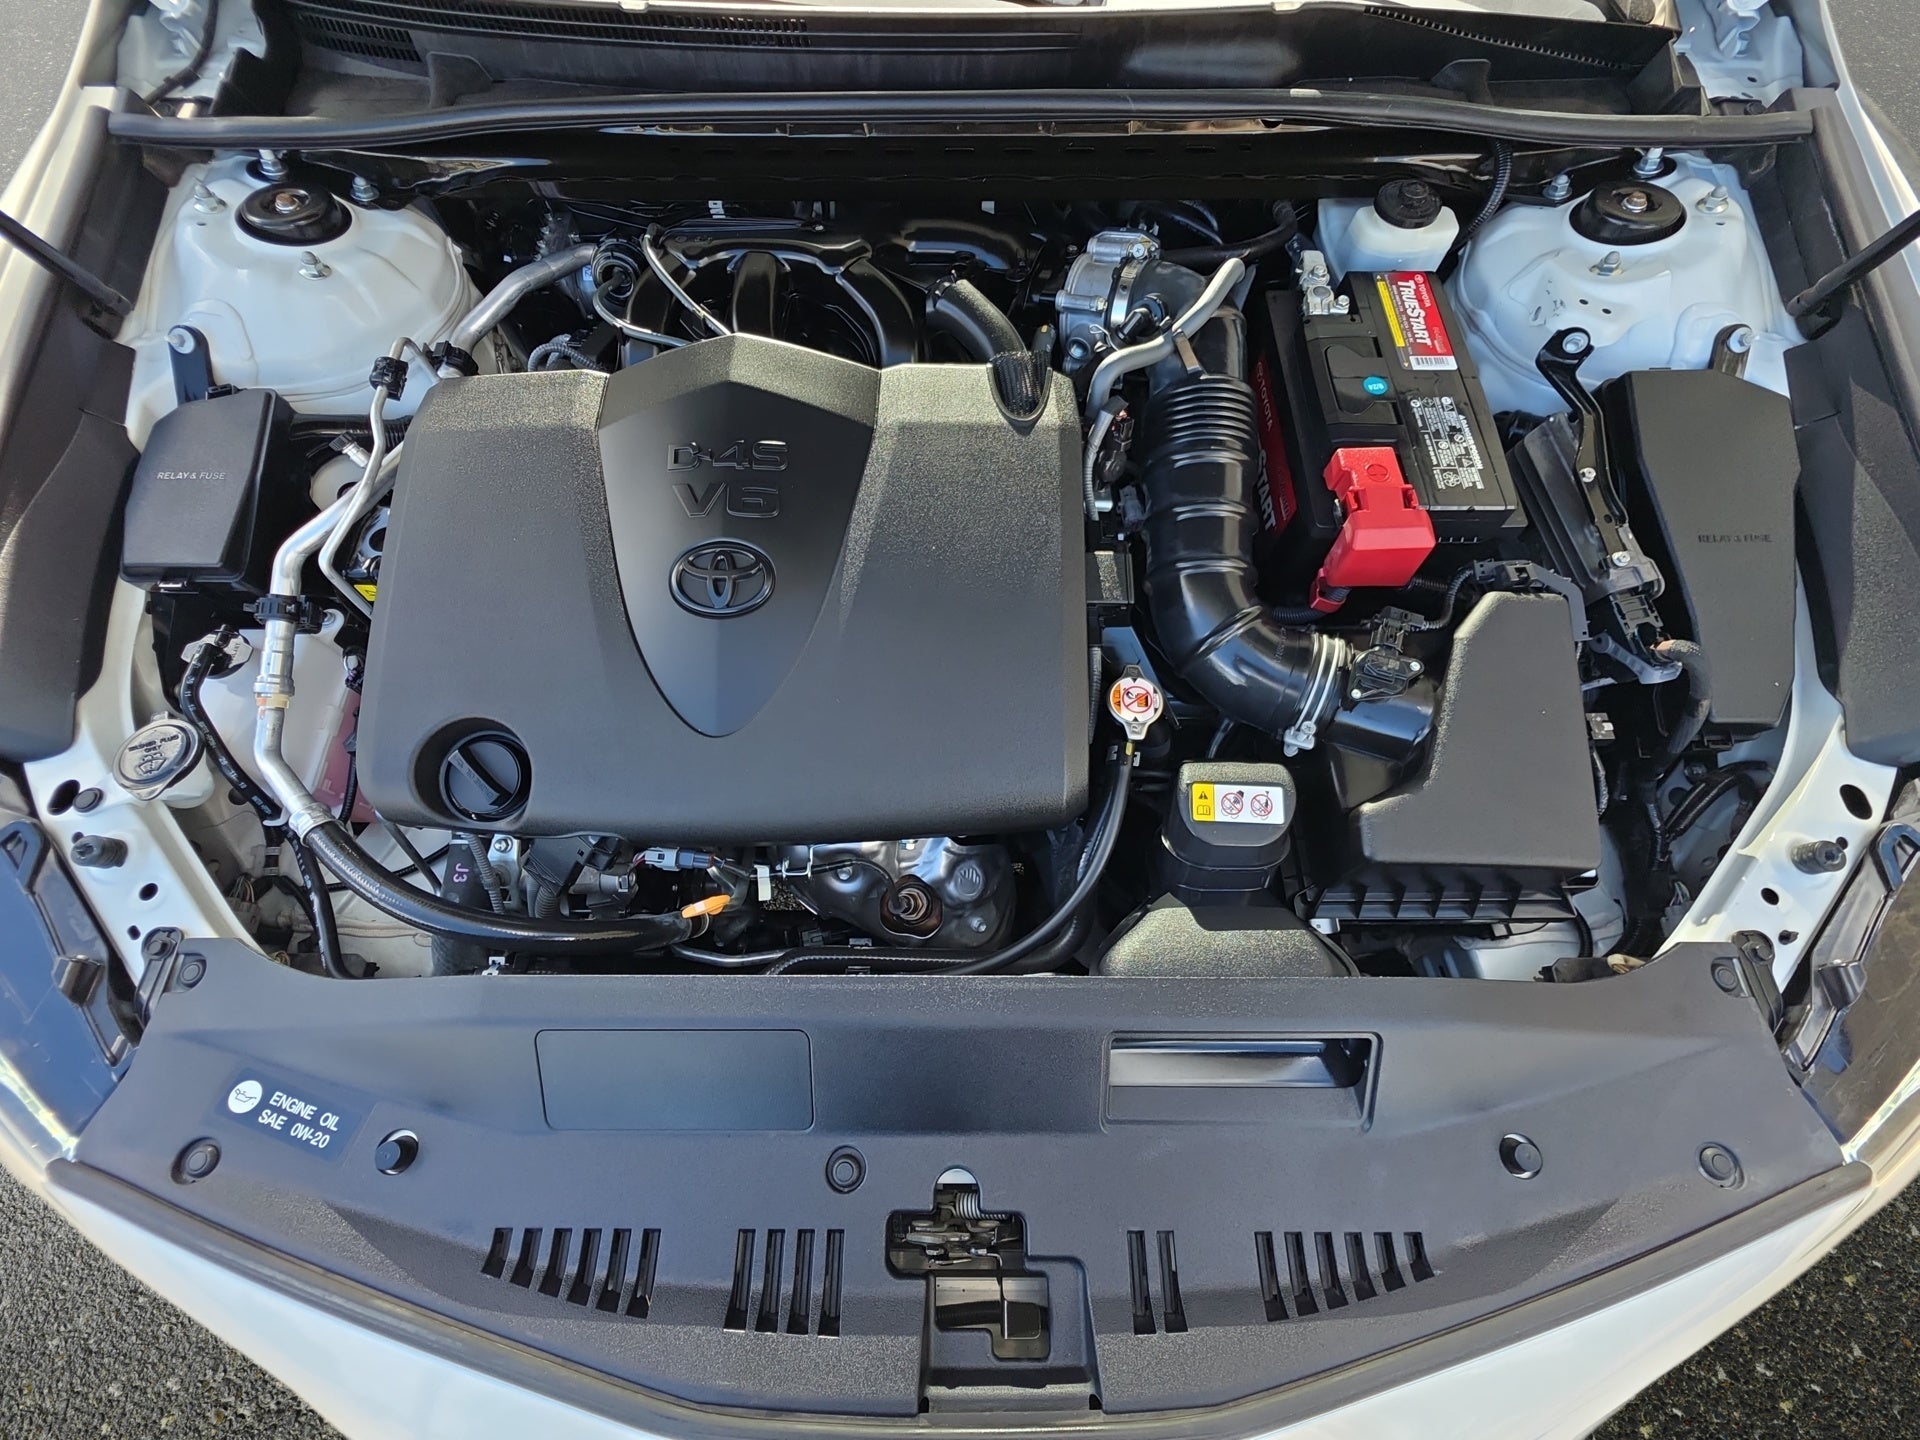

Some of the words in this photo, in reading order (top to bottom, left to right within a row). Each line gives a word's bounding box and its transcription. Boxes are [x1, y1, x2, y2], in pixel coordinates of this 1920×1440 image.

[1419, 284, 1431, 308] TOYOTA
[1257, 379, 1273, 432] TOYOTA
[1461, 420, 1475, 445] DANGER
[1469, 444, 1484, 470] POISON
[156, 471, 189, 480] RELAY
[190, 472, 197, 480] &
[200, 471, 227, 480] FUSE
[1257, 449, 1277, 531] START
[672, 481, 779, 518] V6
[1698, 533, 1731, 543] RELAY
[1744, 533, 1774, 543] FUSE
[144, 744, 162, 753] ONLY
[453, 862, 469, 883] J3
[257, 1108, 289, 1131] SAE
[289, 1122, 330, 1149] 0W-20
[268, 1091, 318, 1120] ENGINE
[319, 1112, 340, 1132] OIL
